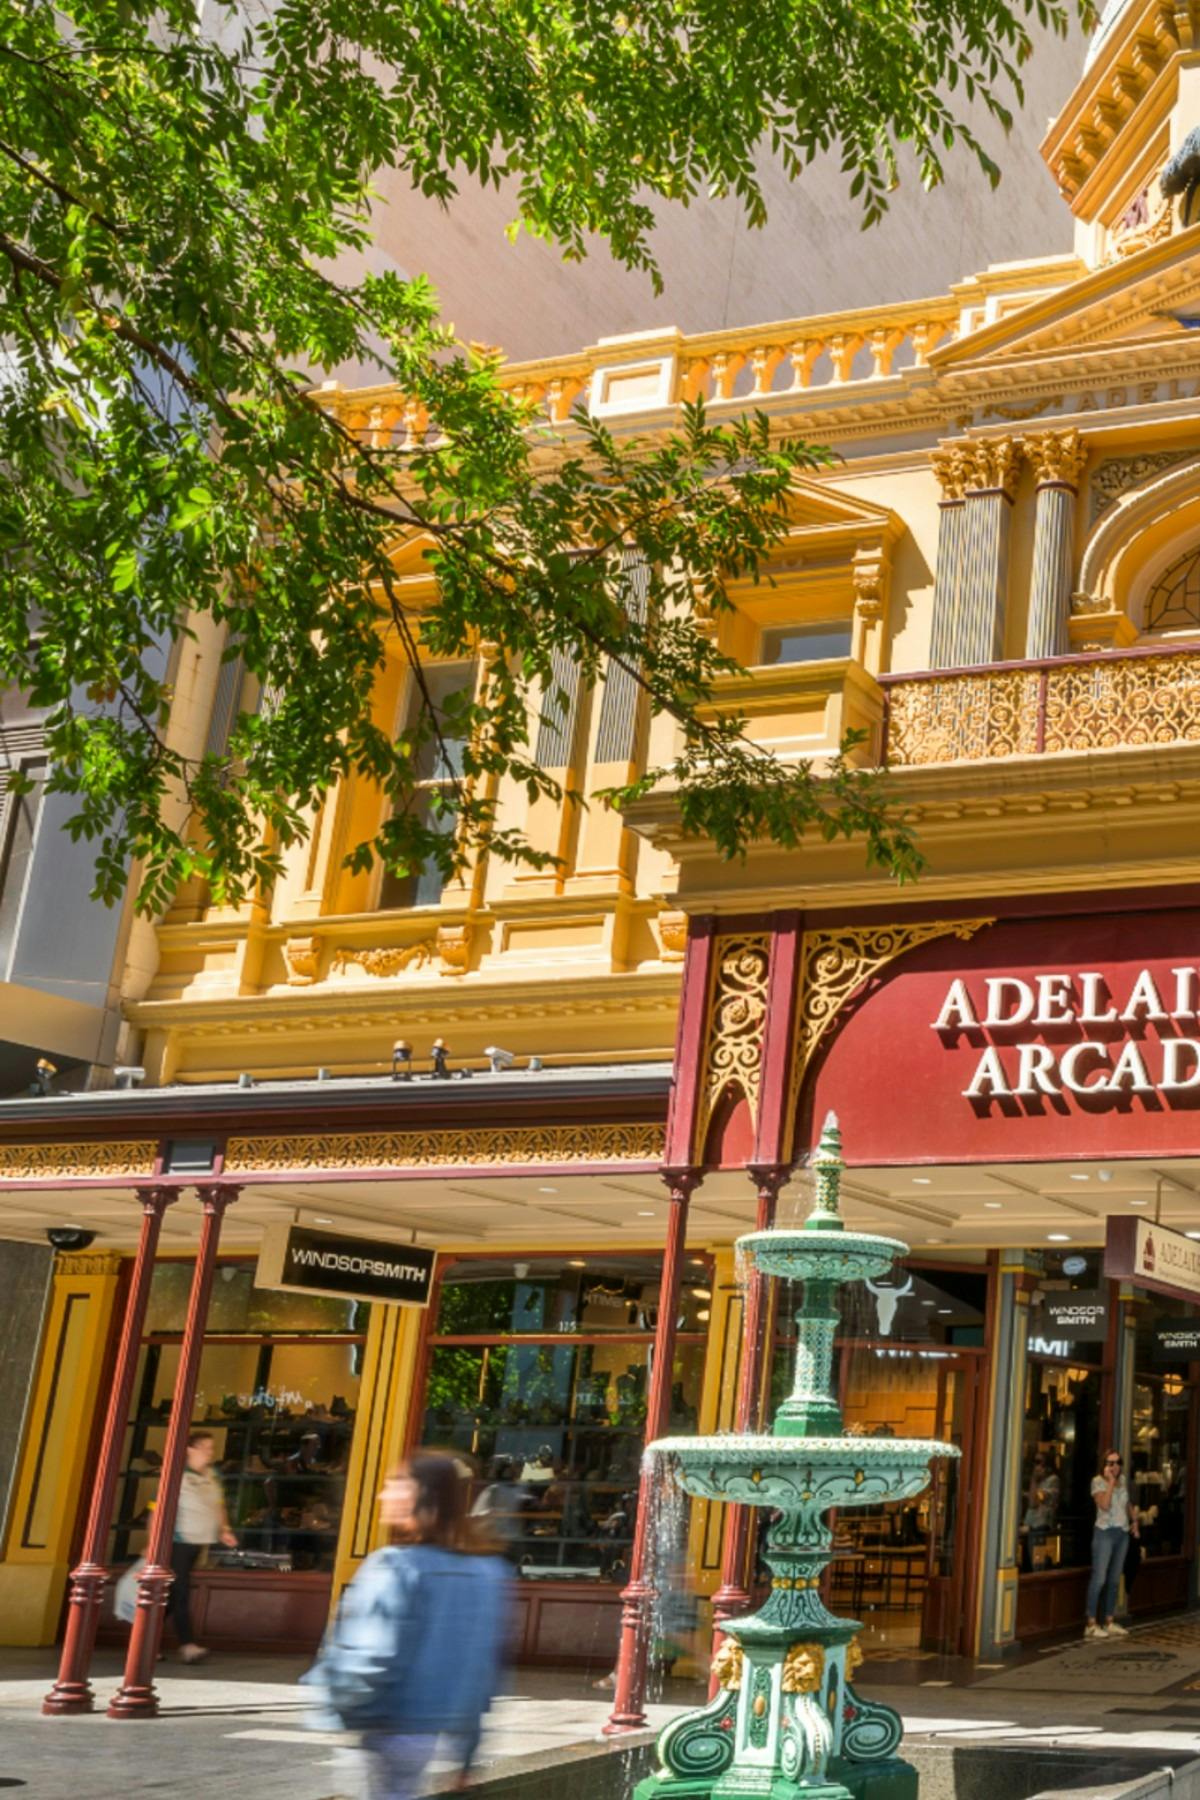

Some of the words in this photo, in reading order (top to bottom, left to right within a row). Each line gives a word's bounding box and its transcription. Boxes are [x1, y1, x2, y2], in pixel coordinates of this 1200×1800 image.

[1049, 1306, 1105, 1316] WINDSOR
[1056, 1316, 1096, 1325] SMITH
[1164, 1340, 1198, 1349] SMITH
